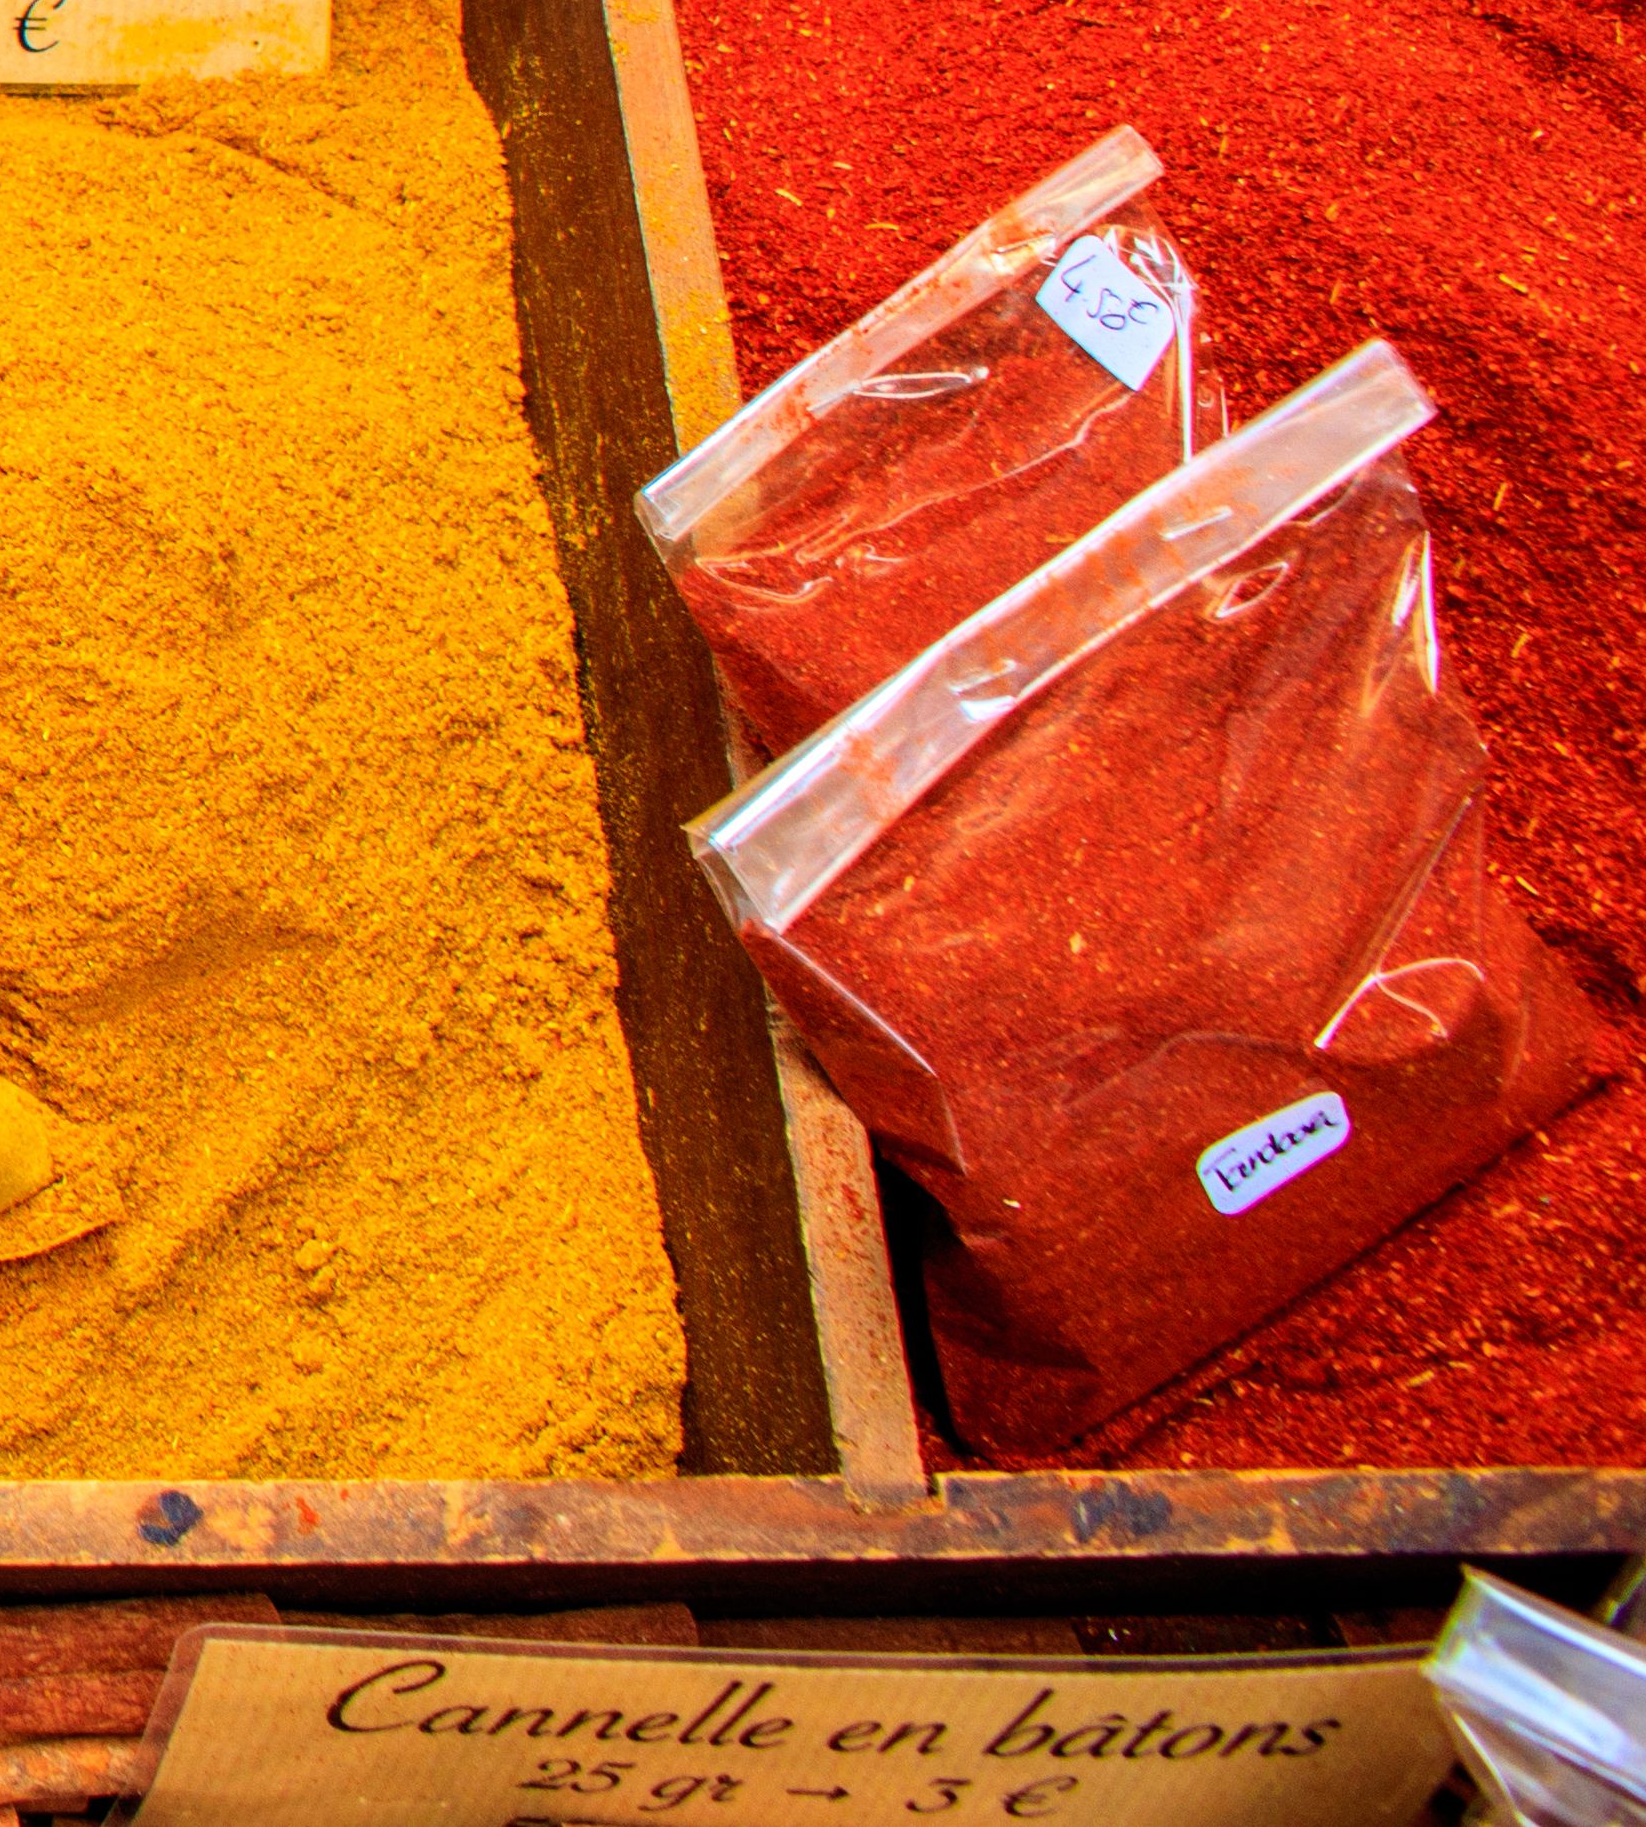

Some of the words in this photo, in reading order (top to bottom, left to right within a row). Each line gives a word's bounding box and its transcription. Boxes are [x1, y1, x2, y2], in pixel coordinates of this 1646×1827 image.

[326, 1659, 789, 1749] Cannelle
[828, 1716, 944, 1756] en
[984, 1687, 1343, 1760] bâtons
[517, 1758, 636, 1793] 25
[639, 1774, 743, 1812] gr
[1002, 1776, 1078, 1817] €
